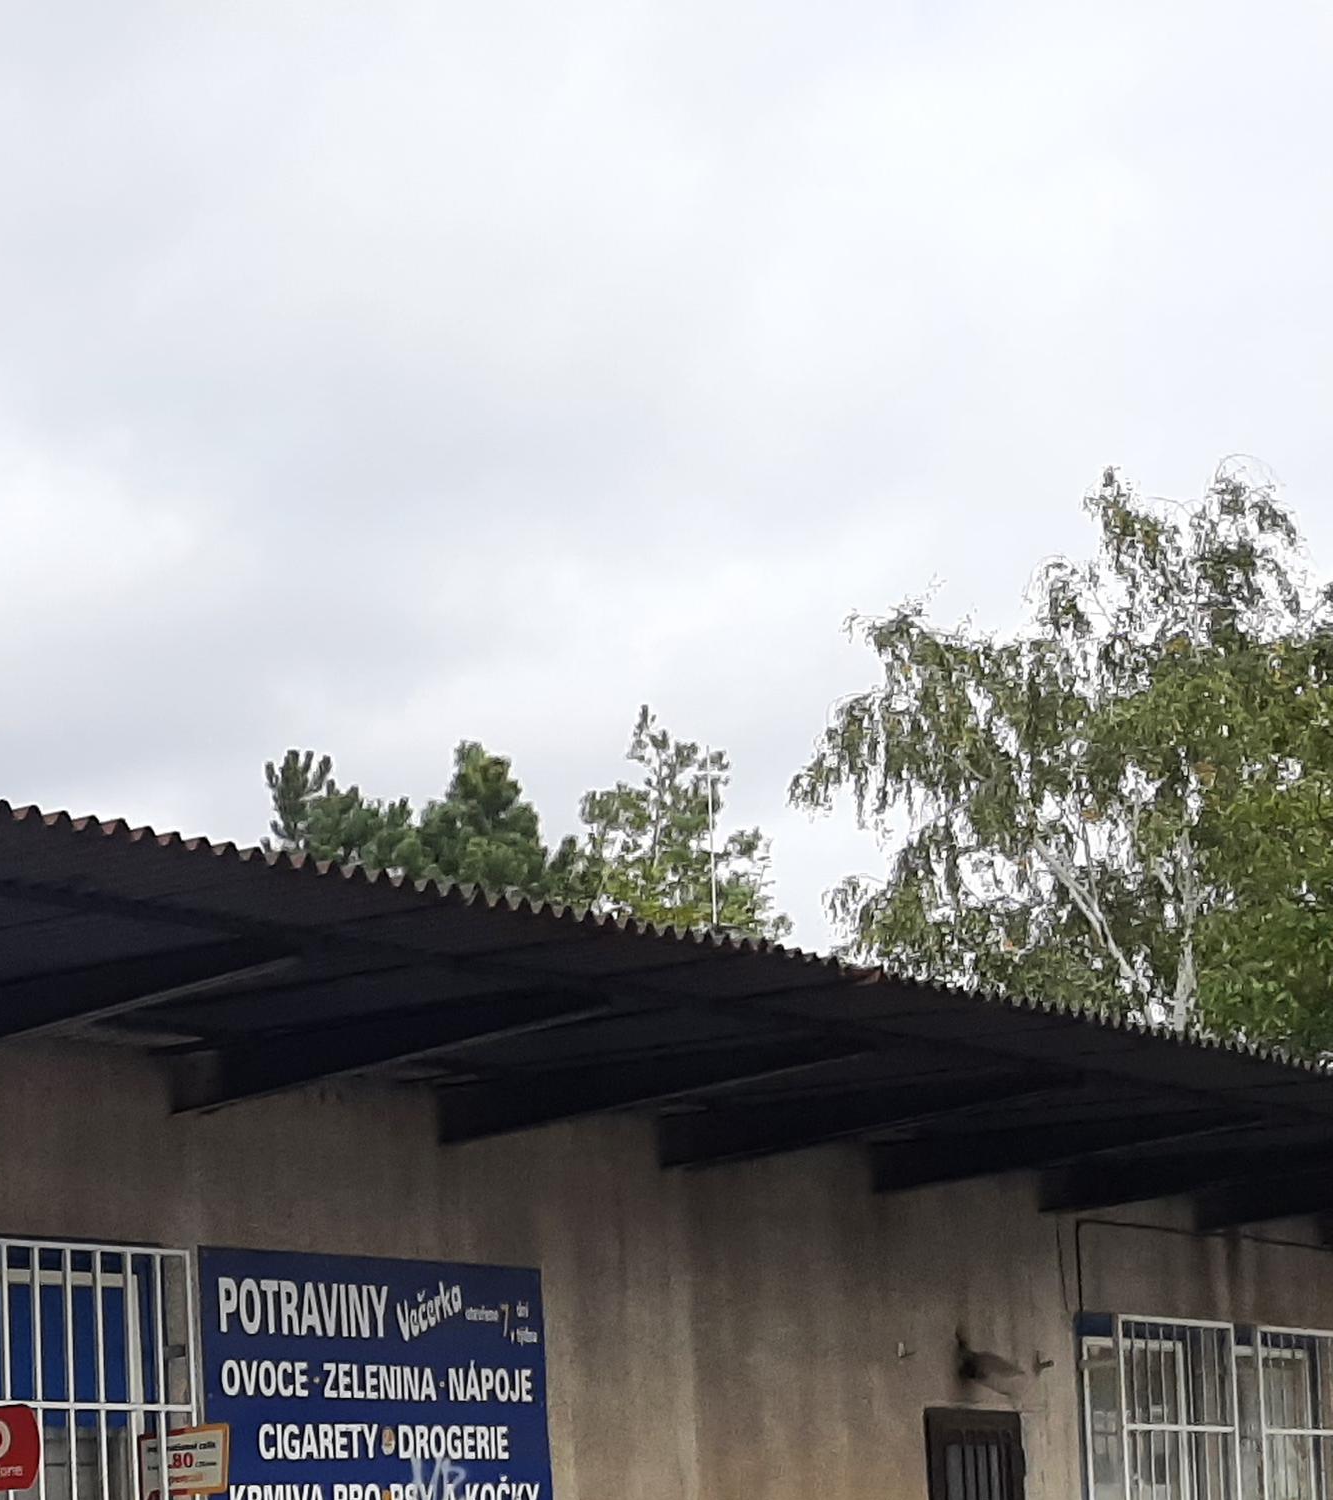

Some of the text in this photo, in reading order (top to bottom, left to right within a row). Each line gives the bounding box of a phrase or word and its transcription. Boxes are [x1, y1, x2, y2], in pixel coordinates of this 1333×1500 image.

[218, 1277, 462, 1342] POTRAVINY Večerka
[221, 1359, 533, 1402] OVOCE ZELENINA NÁPOJE
[258, 1423, 509, 1460] CIGARETY DROGERIE
